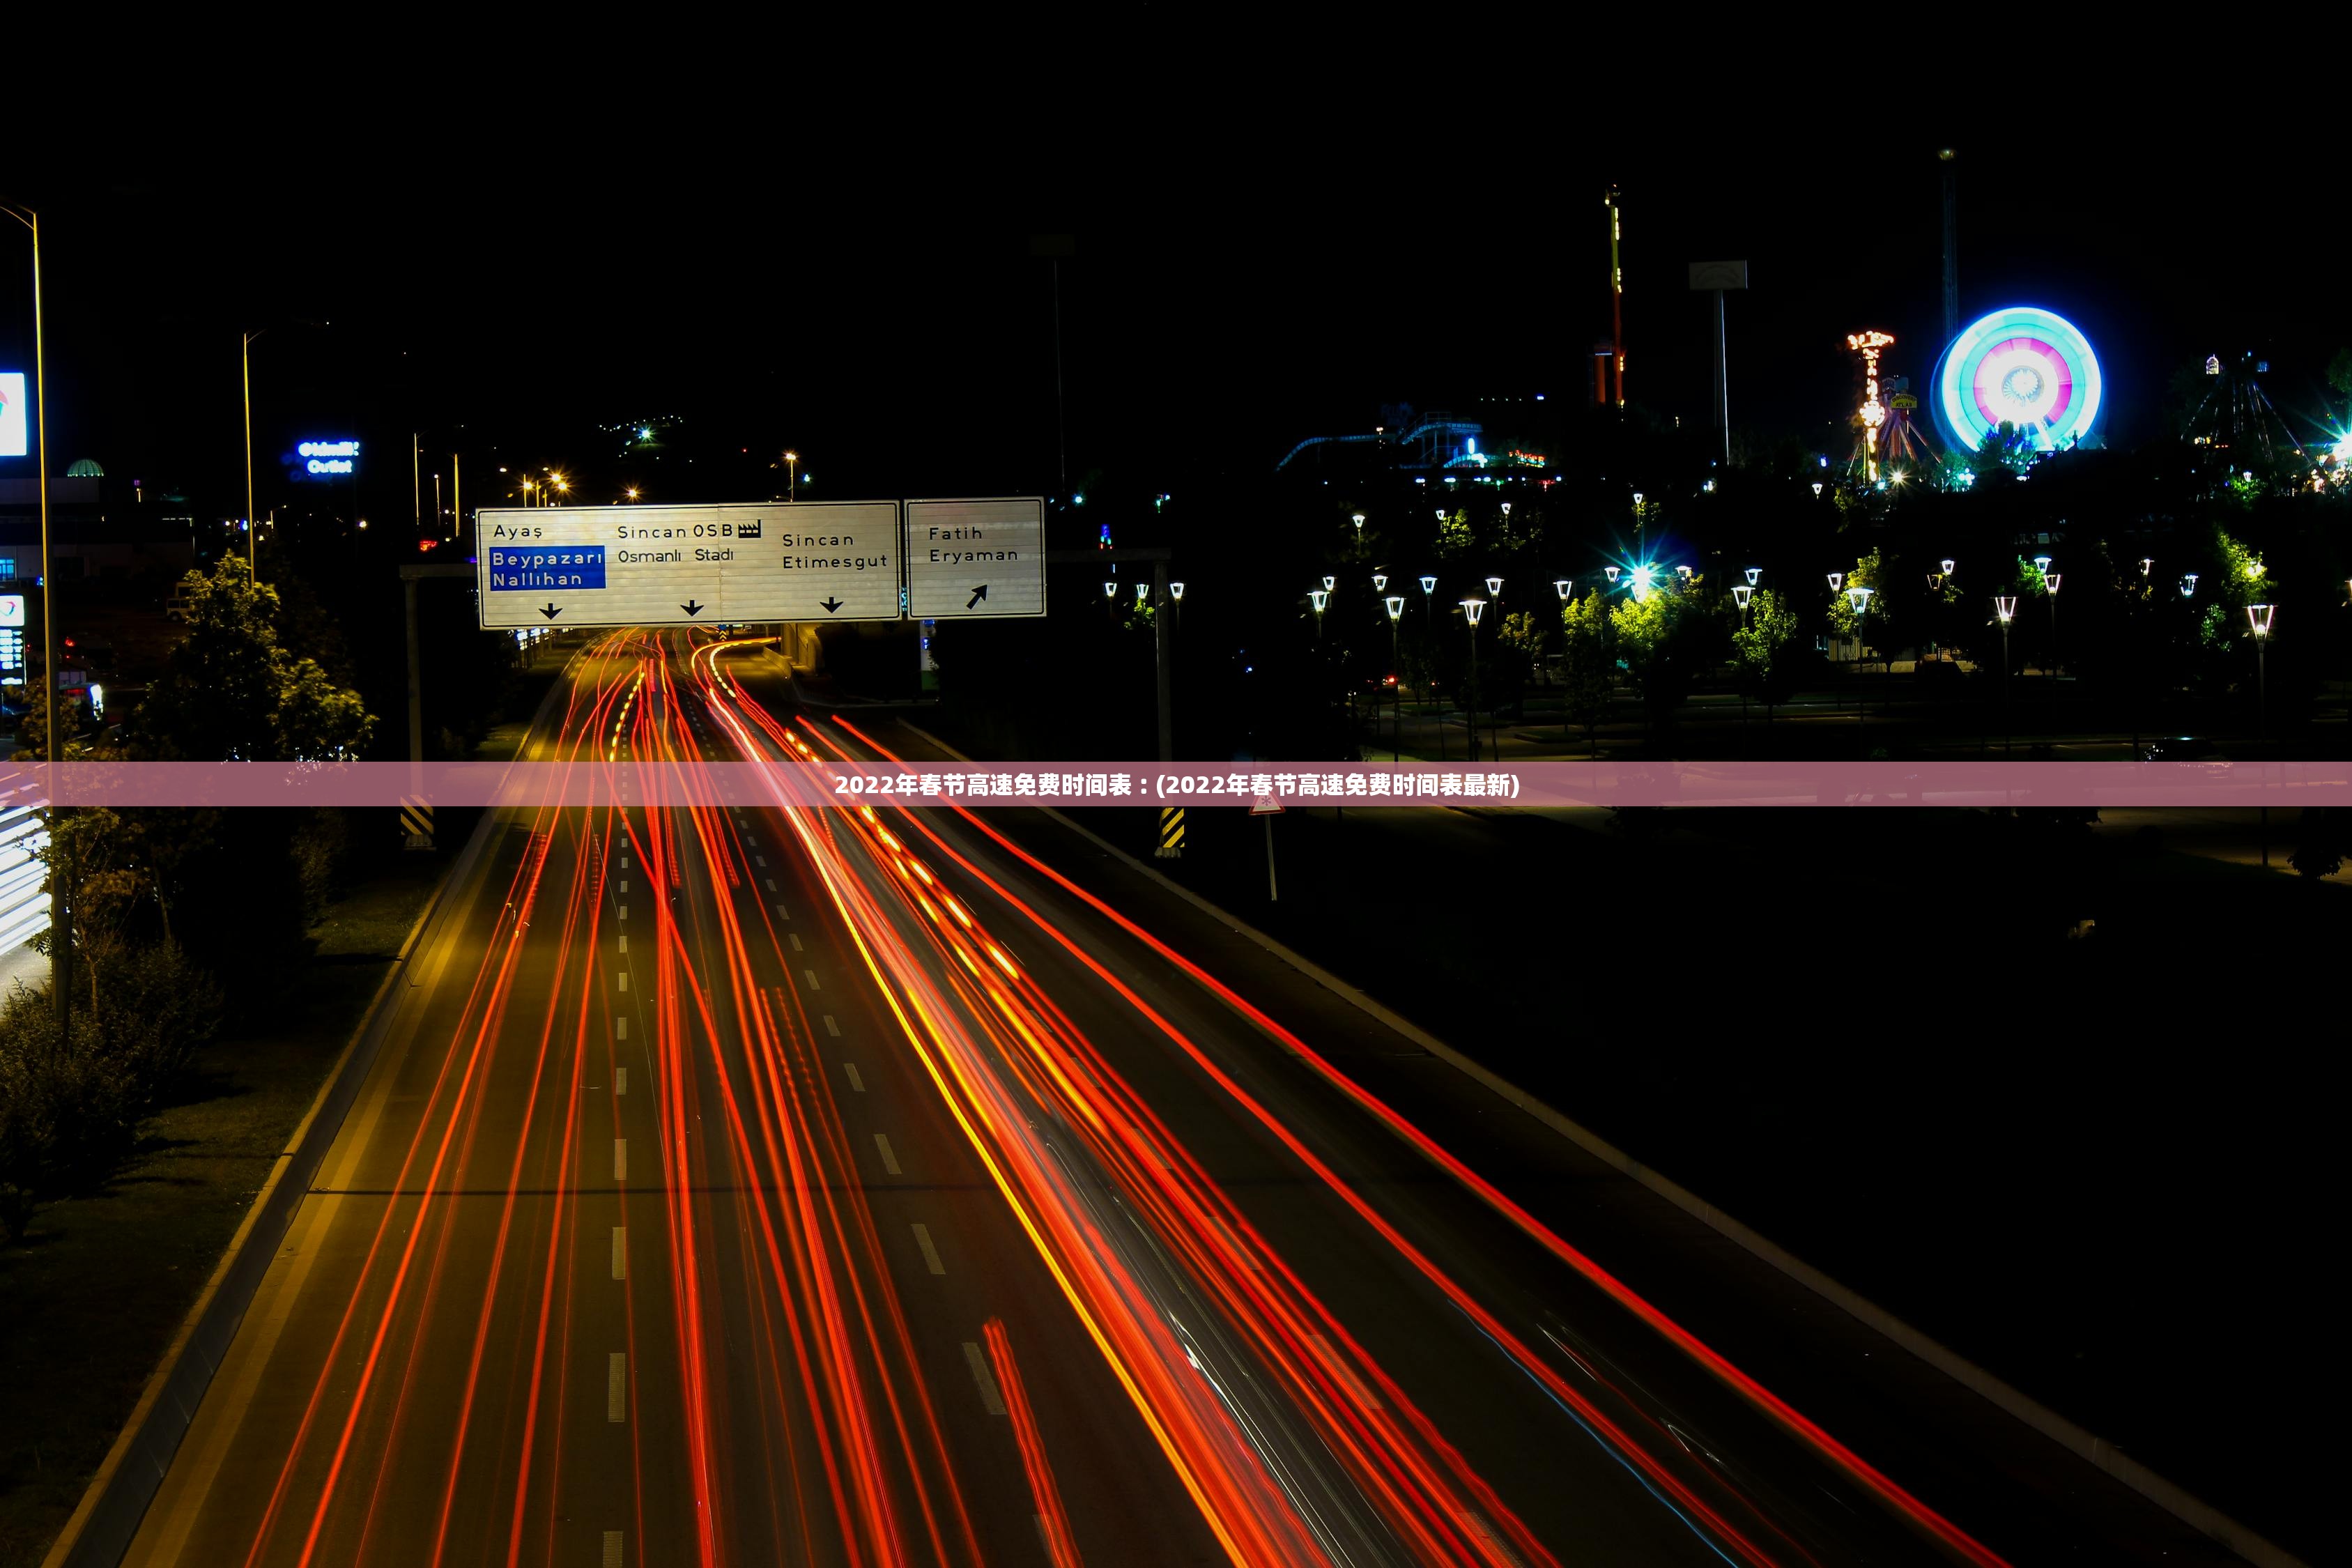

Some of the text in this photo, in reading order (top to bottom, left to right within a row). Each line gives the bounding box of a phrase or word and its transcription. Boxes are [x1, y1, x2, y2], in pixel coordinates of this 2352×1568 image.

[494, 525, 542, 539] Ayaş
[618, 524, 732, 539] Sincan OSB
[930, 527, 983, 540] Fatih
[783, 535, 854, 547] Sincan
[493, 552, 601, 569] Beypazarı
[618, 548, 734, 562] Osmanlı Stadı
[930, 549, 1017, 564] Eryaman
[783, 555, 886, 570] Etimesgut
